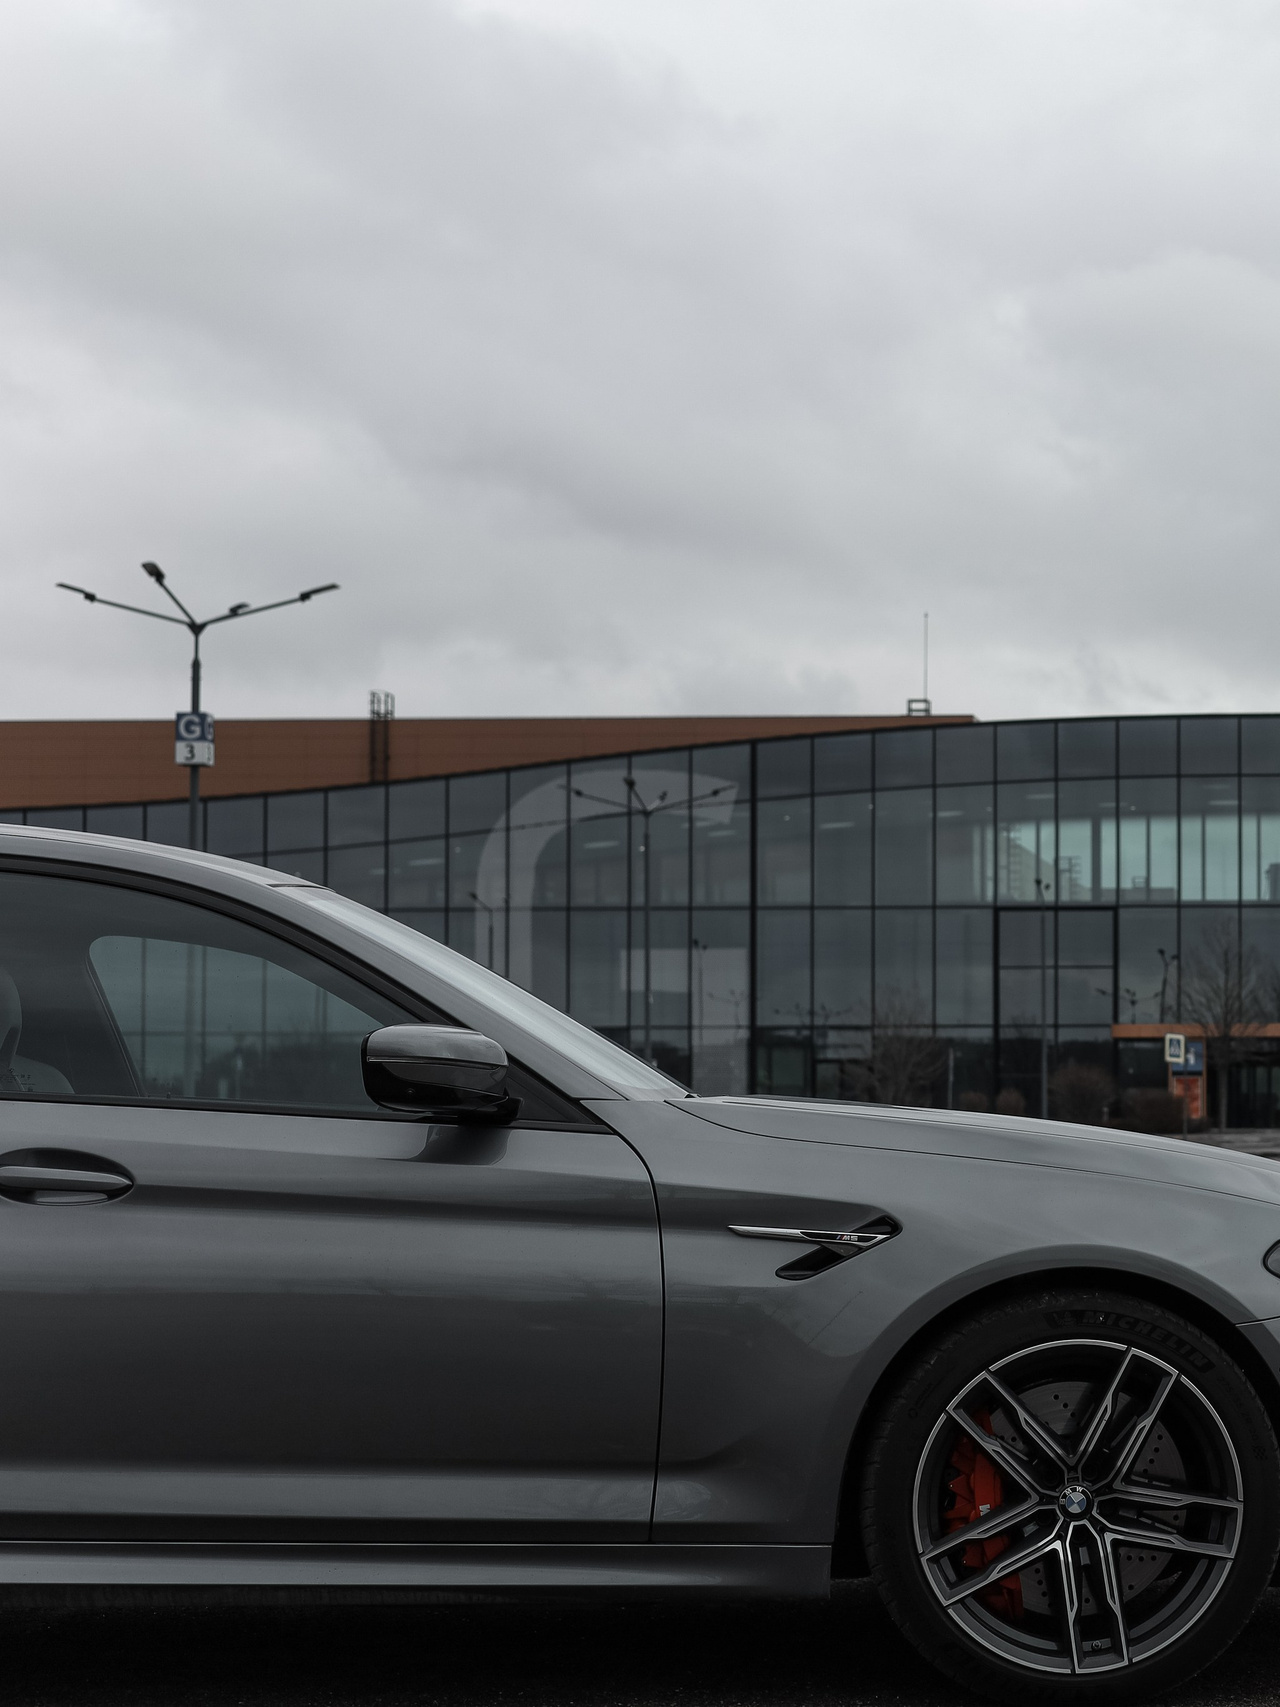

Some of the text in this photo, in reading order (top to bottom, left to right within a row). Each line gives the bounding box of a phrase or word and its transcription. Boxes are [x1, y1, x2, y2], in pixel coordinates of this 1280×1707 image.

[179, 714, 201, 738] G
[184, 742, 196, 761] 3
[1082, 1310, 1209, 1368] MICHELIN
[1060, 1486, 1084, 1504] BMW
